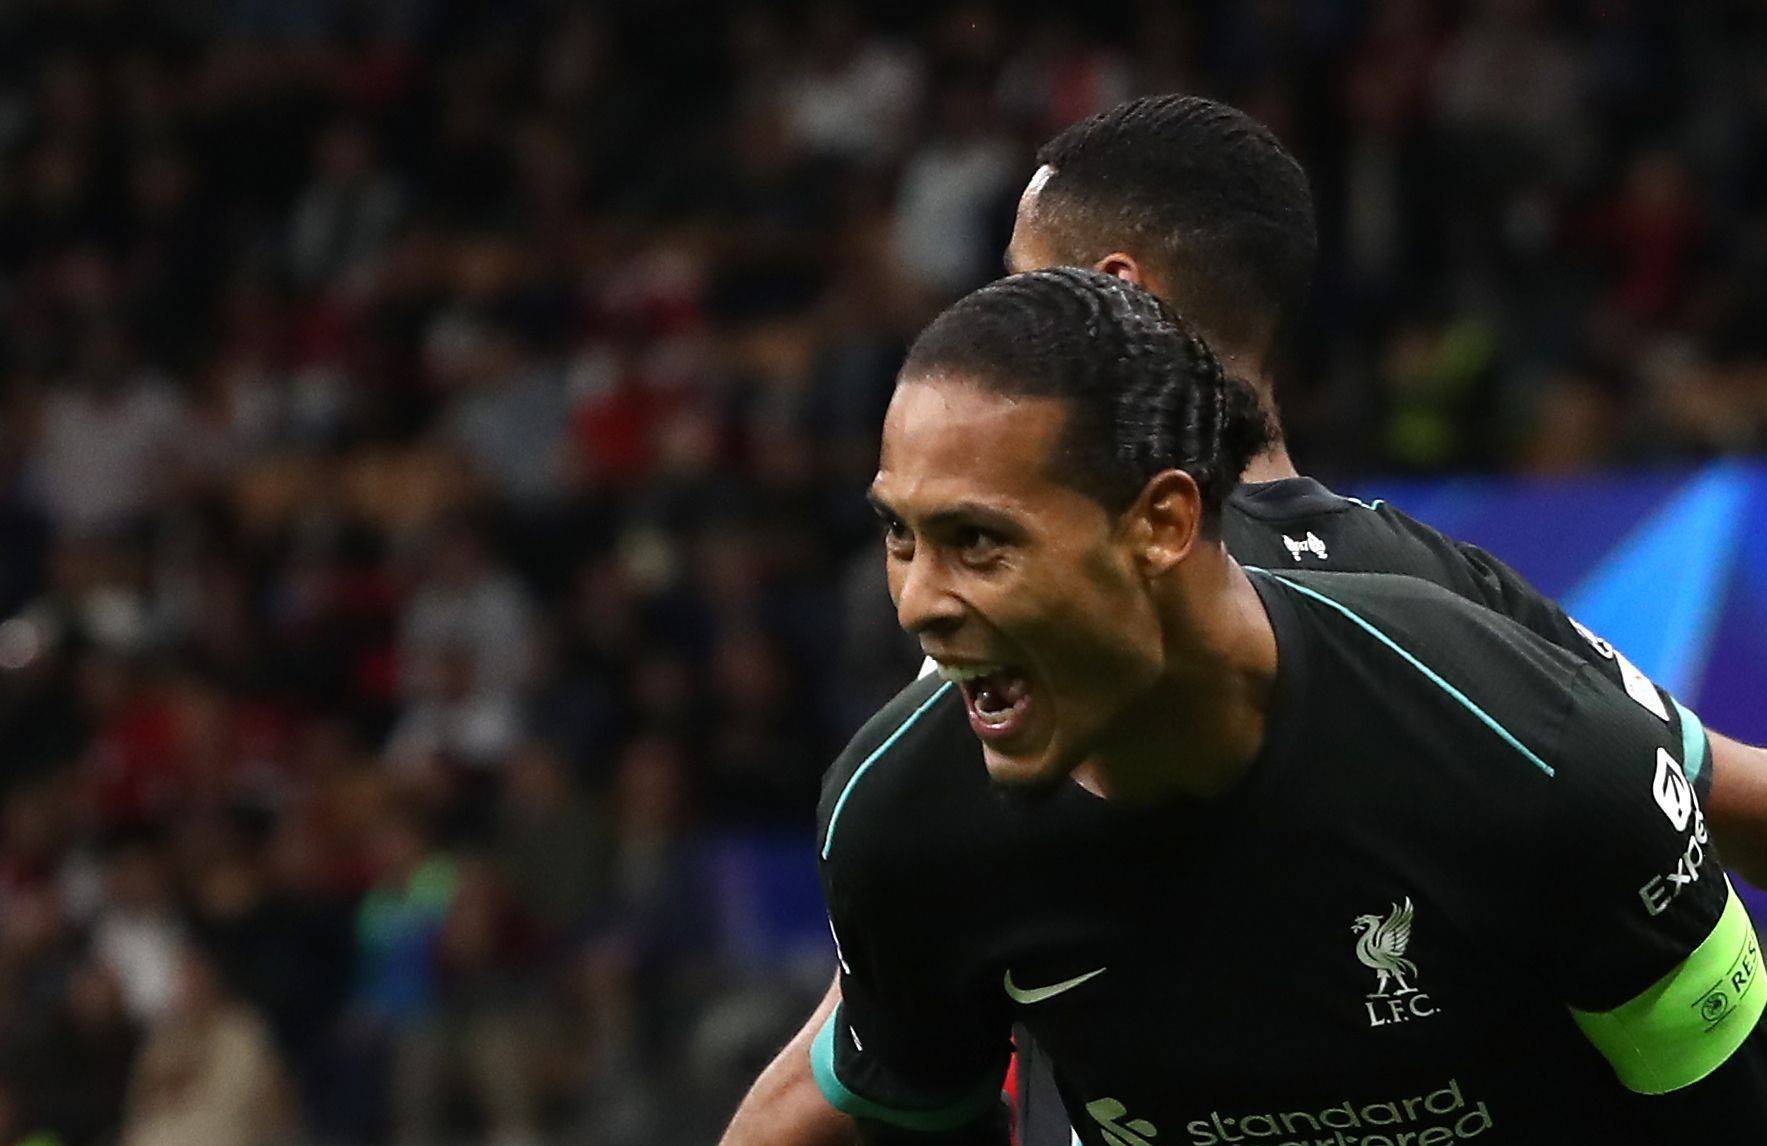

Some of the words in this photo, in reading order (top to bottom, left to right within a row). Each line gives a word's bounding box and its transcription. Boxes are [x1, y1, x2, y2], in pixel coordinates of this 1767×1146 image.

[1638, 808, 1708, 916] Expe
[1731, 939, 1757, 993] RES
[1365, 993, 1441, 1027] L.F.C.
[1187, 1078, 1466, 1146] standard
